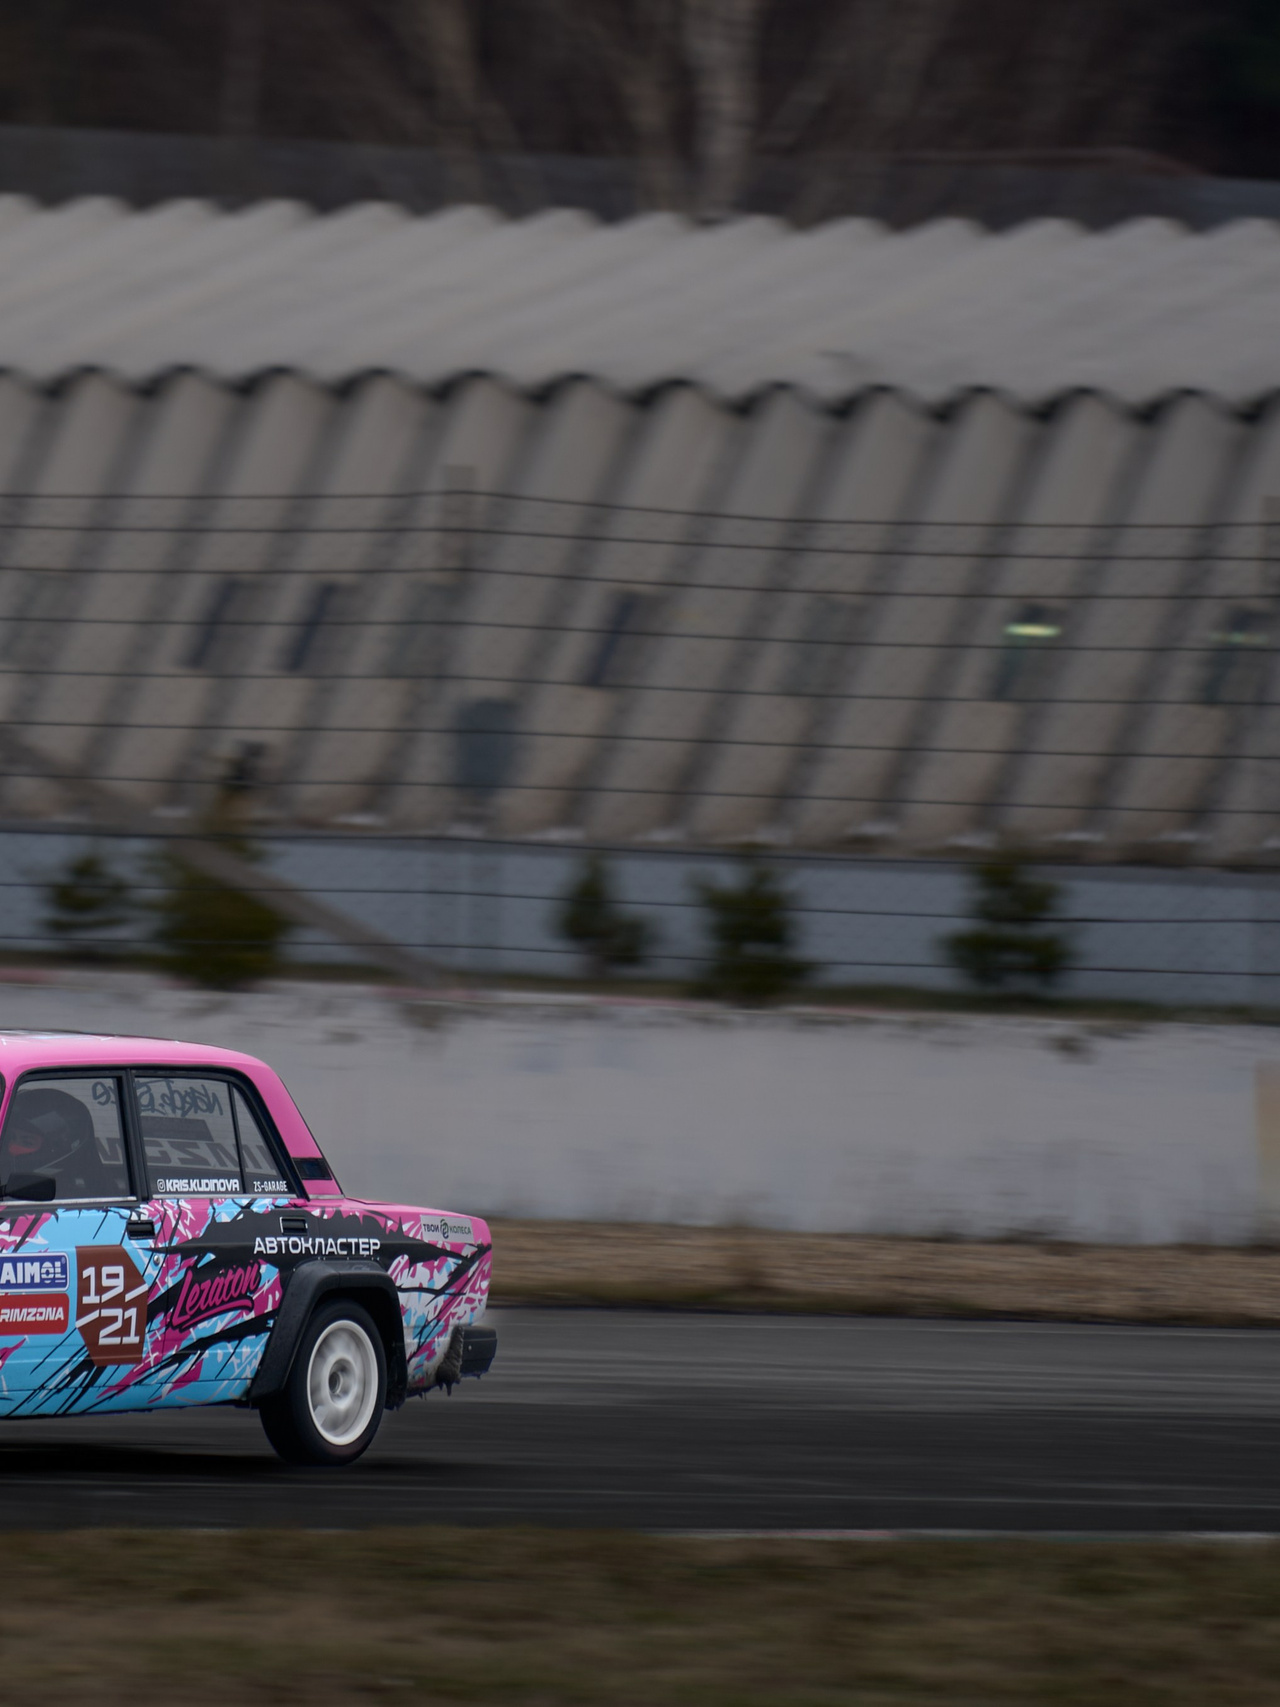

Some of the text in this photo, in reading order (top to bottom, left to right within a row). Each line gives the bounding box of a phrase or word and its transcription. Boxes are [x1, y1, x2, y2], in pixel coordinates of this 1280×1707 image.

[253, 1236, 381, 1256] АВТОКЛАСТЕР
[0, 1261, 66, 1285] AIMOL
[82, 1265, 125, 1304] 19
[0, 1306, 65, 1323] RIMZONA
[98, 1307, 140, 1346] 21
